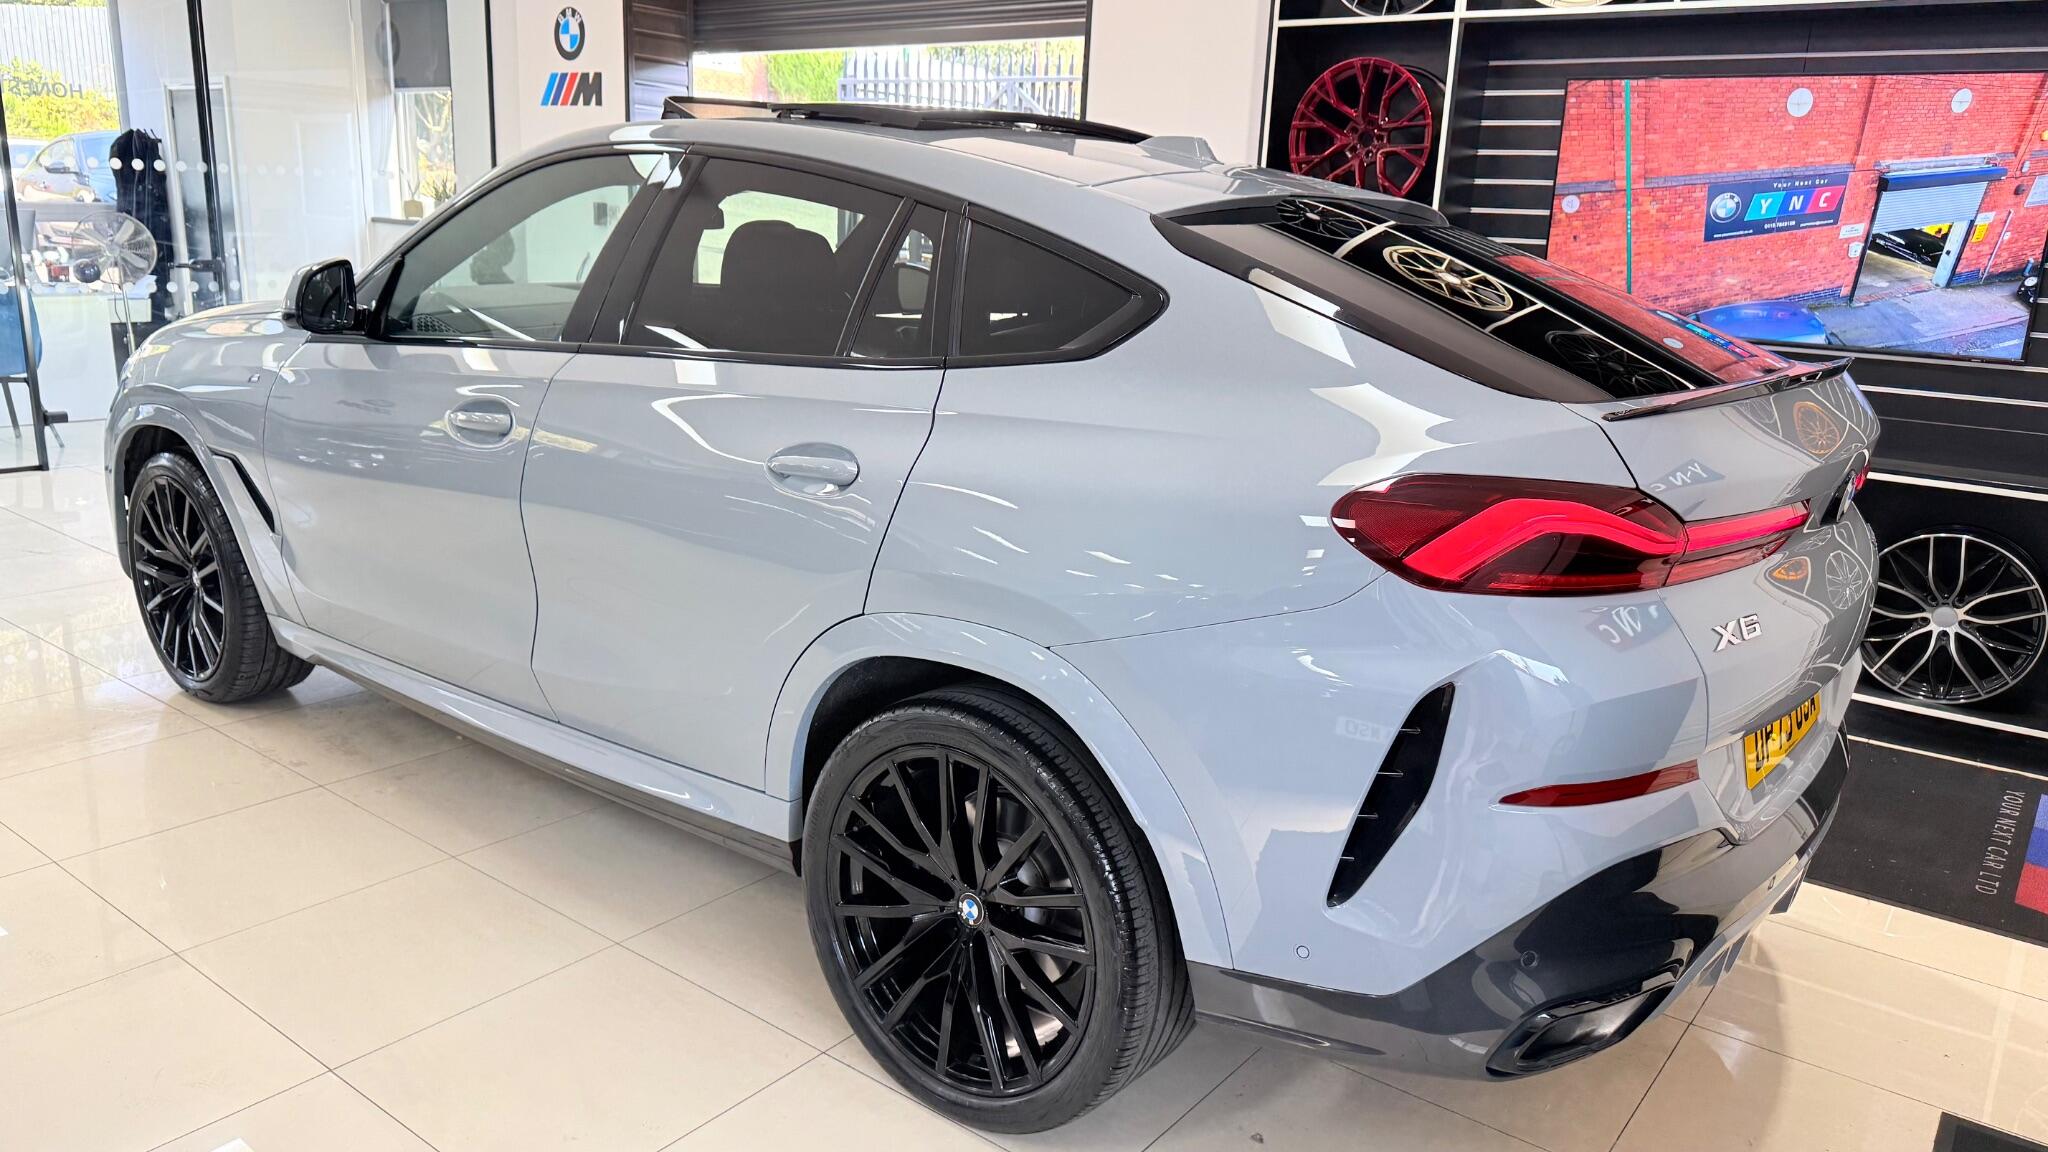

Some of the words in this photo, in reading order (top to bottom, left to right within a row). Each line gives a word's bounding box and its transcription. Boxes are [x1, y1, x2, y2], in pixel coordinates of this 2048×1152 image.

[1711, 612, 1763, 652] X6
[1999, 790, 2026, 816] YOUR
[1990, 816, 2017, 846] NEXT
[1982, 846, 2009, 869] CAR
[1975, 870, 2002, 895] LTD
